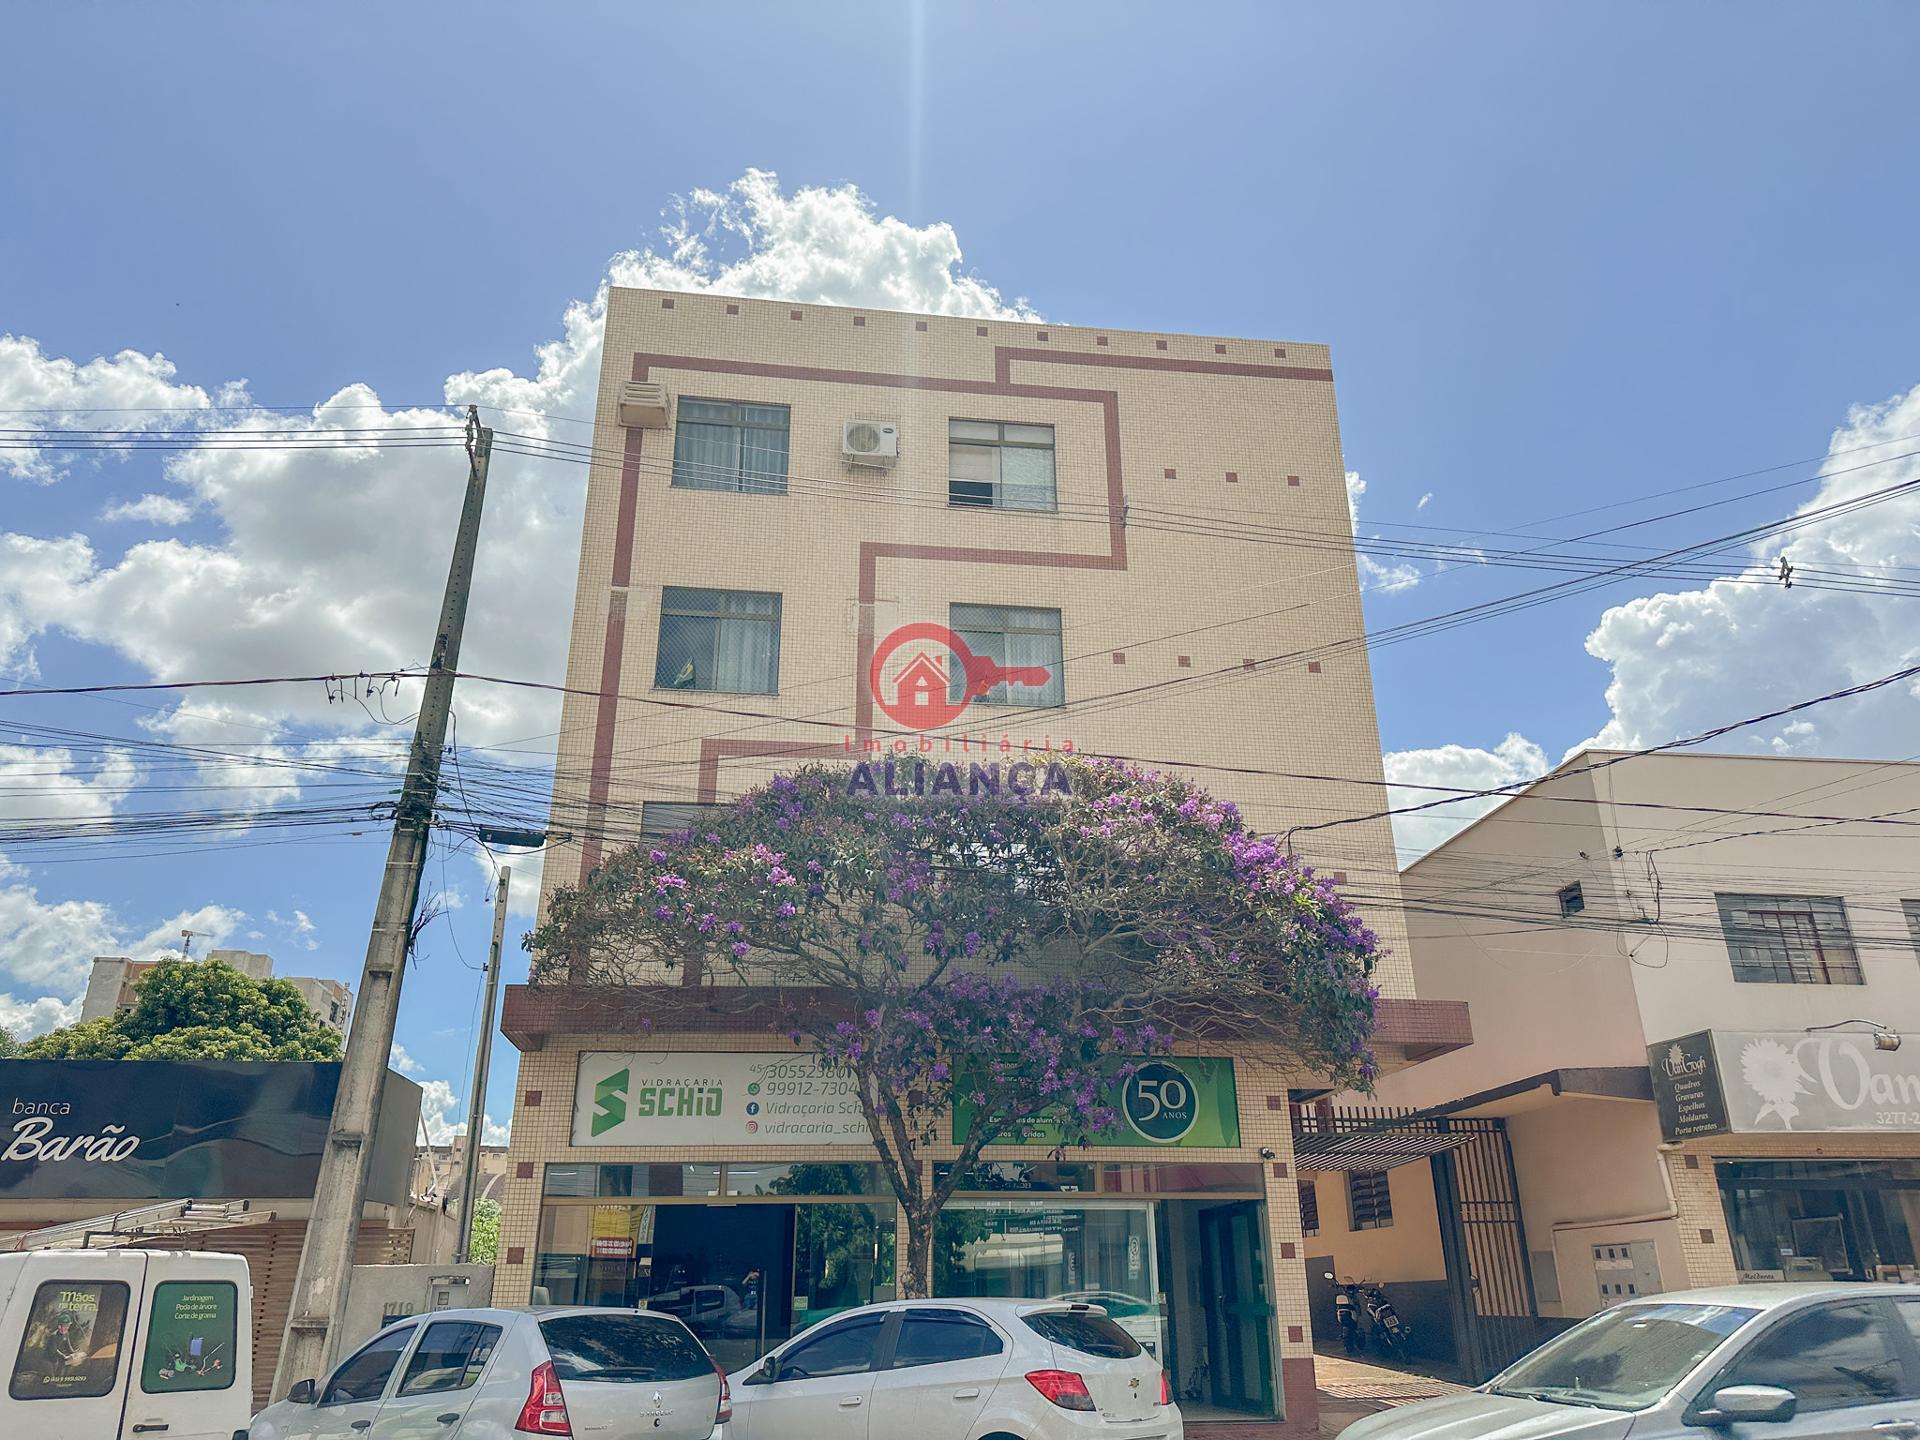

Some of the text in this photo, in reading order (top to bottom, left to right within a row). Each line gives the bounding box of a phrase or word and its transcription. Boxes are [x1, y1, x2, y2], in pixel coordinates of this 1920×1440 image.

[749, 1063, 763, 1073] 45
[641, 1078, 723, 1087] VIDRAÇARIA
[1674, 1080, 1701, 1092] Quadros
[1138, 1079, 1187, 1121] 50
[1675, 1091, 1705, 1102] Gravuras
[12, 1097, 71, 1115] banca
[766, 1101, 864, 1118] Vidraçaria Sch
[1678, 1102, 1706, 1114] Espelhos
[1162, 1111, 1187, 1120] ANOS
[1678, 1113, 1709, 1124] Molduras
[0, 1116, 141, 1162] Barão
